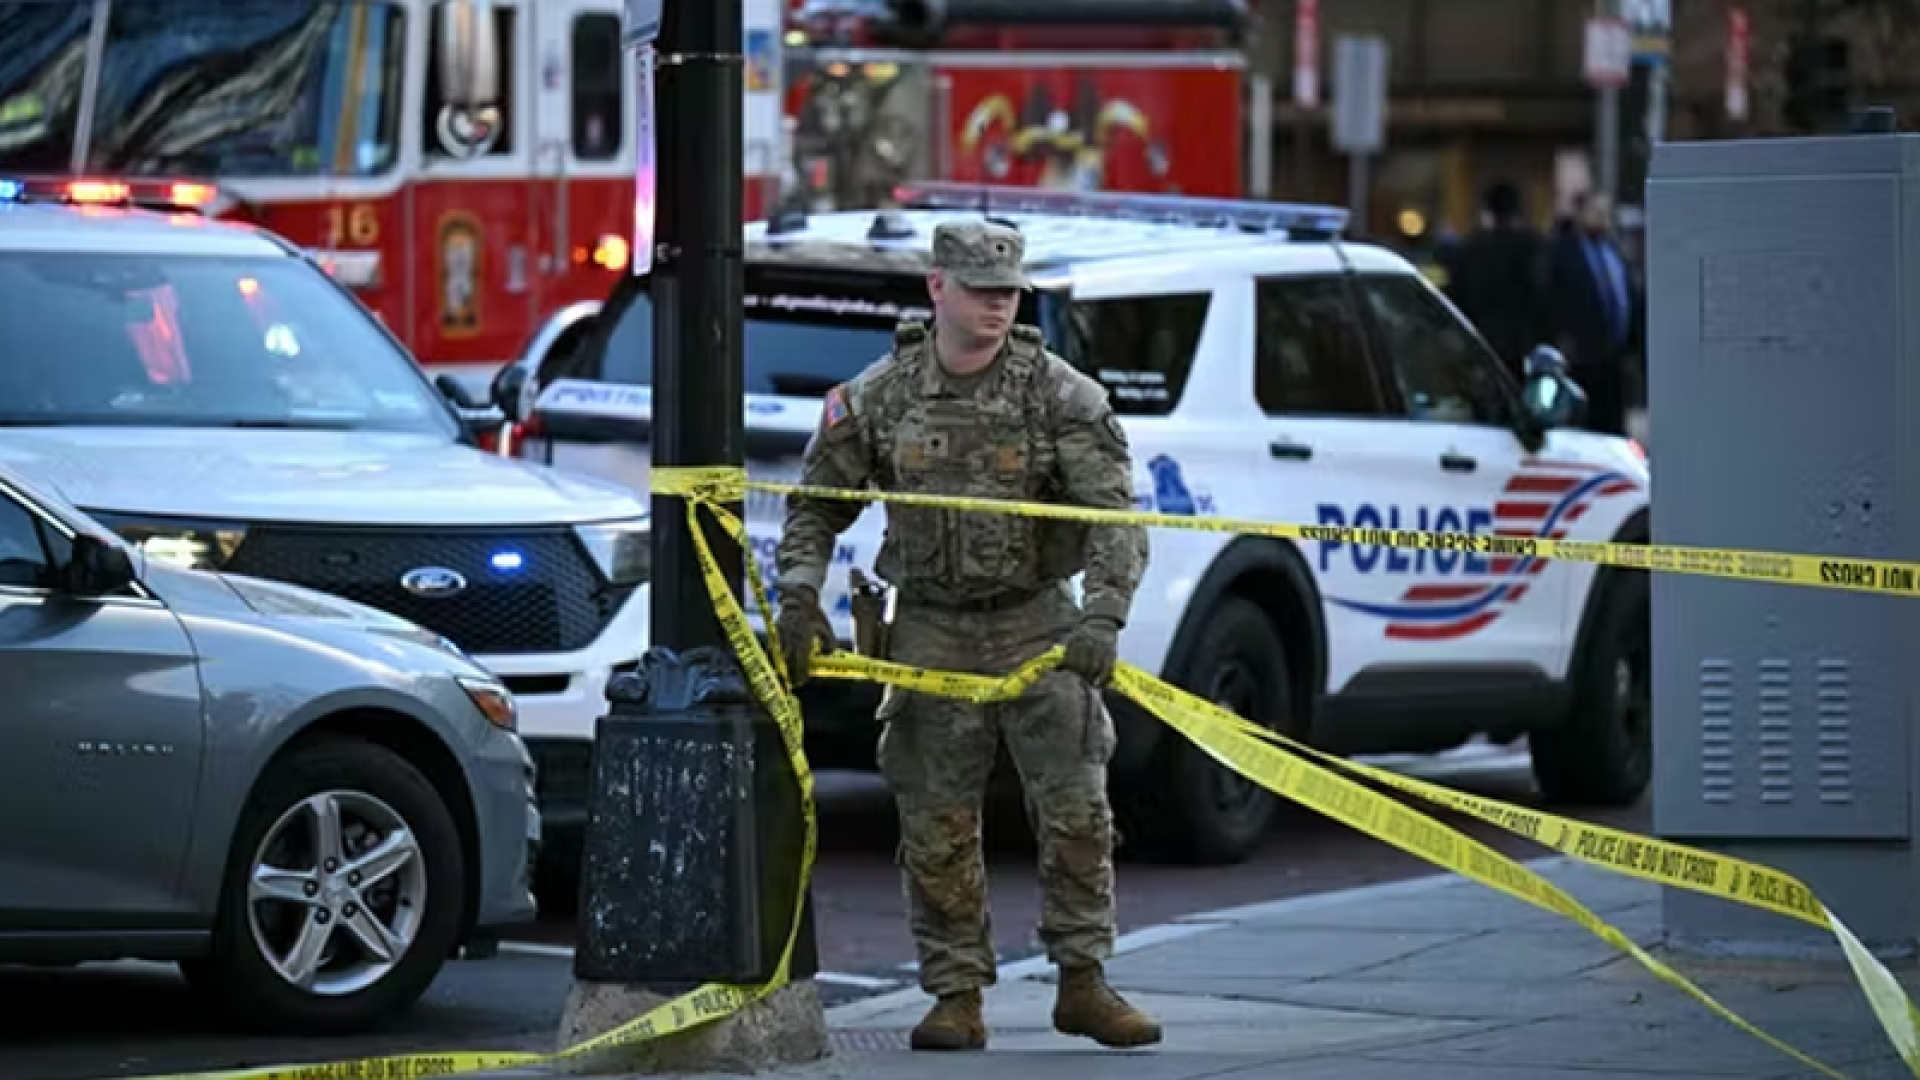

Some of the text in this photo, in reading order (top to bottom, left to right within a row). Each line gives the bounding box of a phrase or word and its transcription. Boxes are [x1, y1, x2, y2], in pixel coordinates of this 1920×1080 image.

[327, 206, 380, 245] 16
[1316, 503, 1492, 574] POLICE
[1820, 560, 1876, 587] CROSS
[1575, 829, 1719, 887] POLICE LINE DO NOT CROSS
[413, 1056, 455, 1074] CROSS
